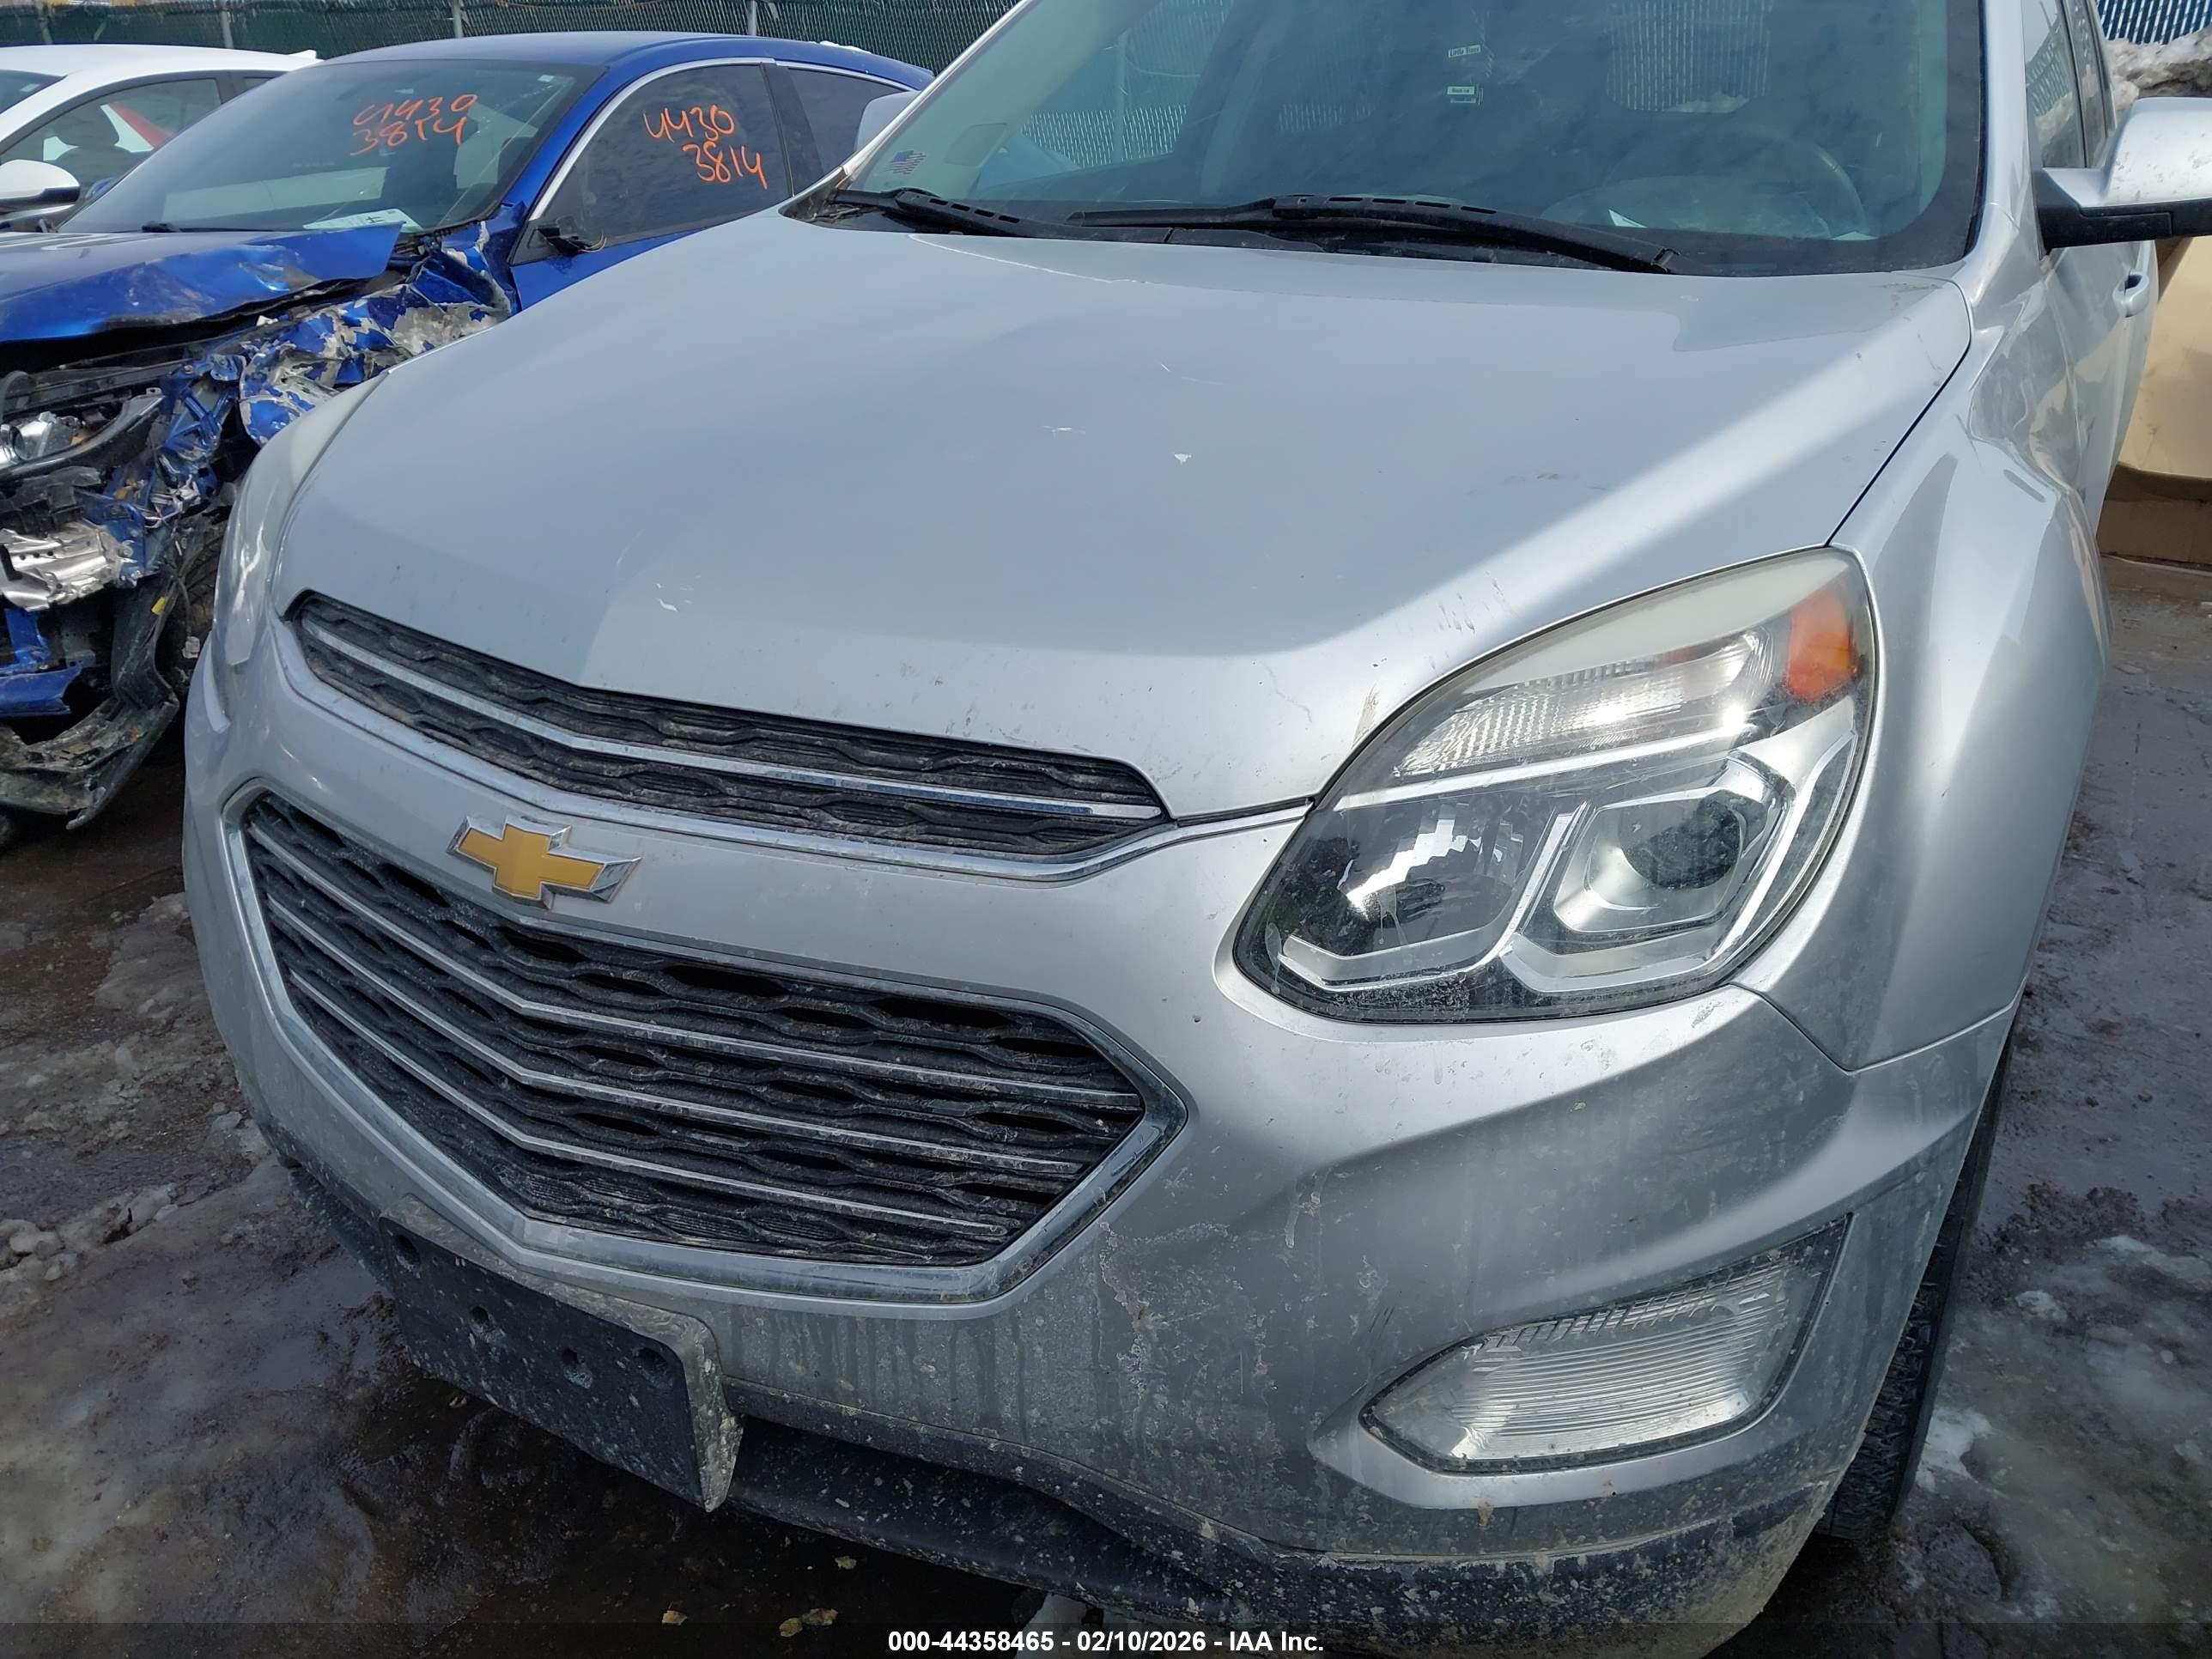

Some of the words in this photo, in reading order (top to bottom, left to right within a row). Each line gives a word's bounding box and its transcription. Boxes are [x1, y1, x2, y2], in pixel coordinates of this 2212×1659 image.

[349, 116, 467, 155] 3814
[642, 104, 735, 143] 4430
[682, 140, 768, 190] 3814
